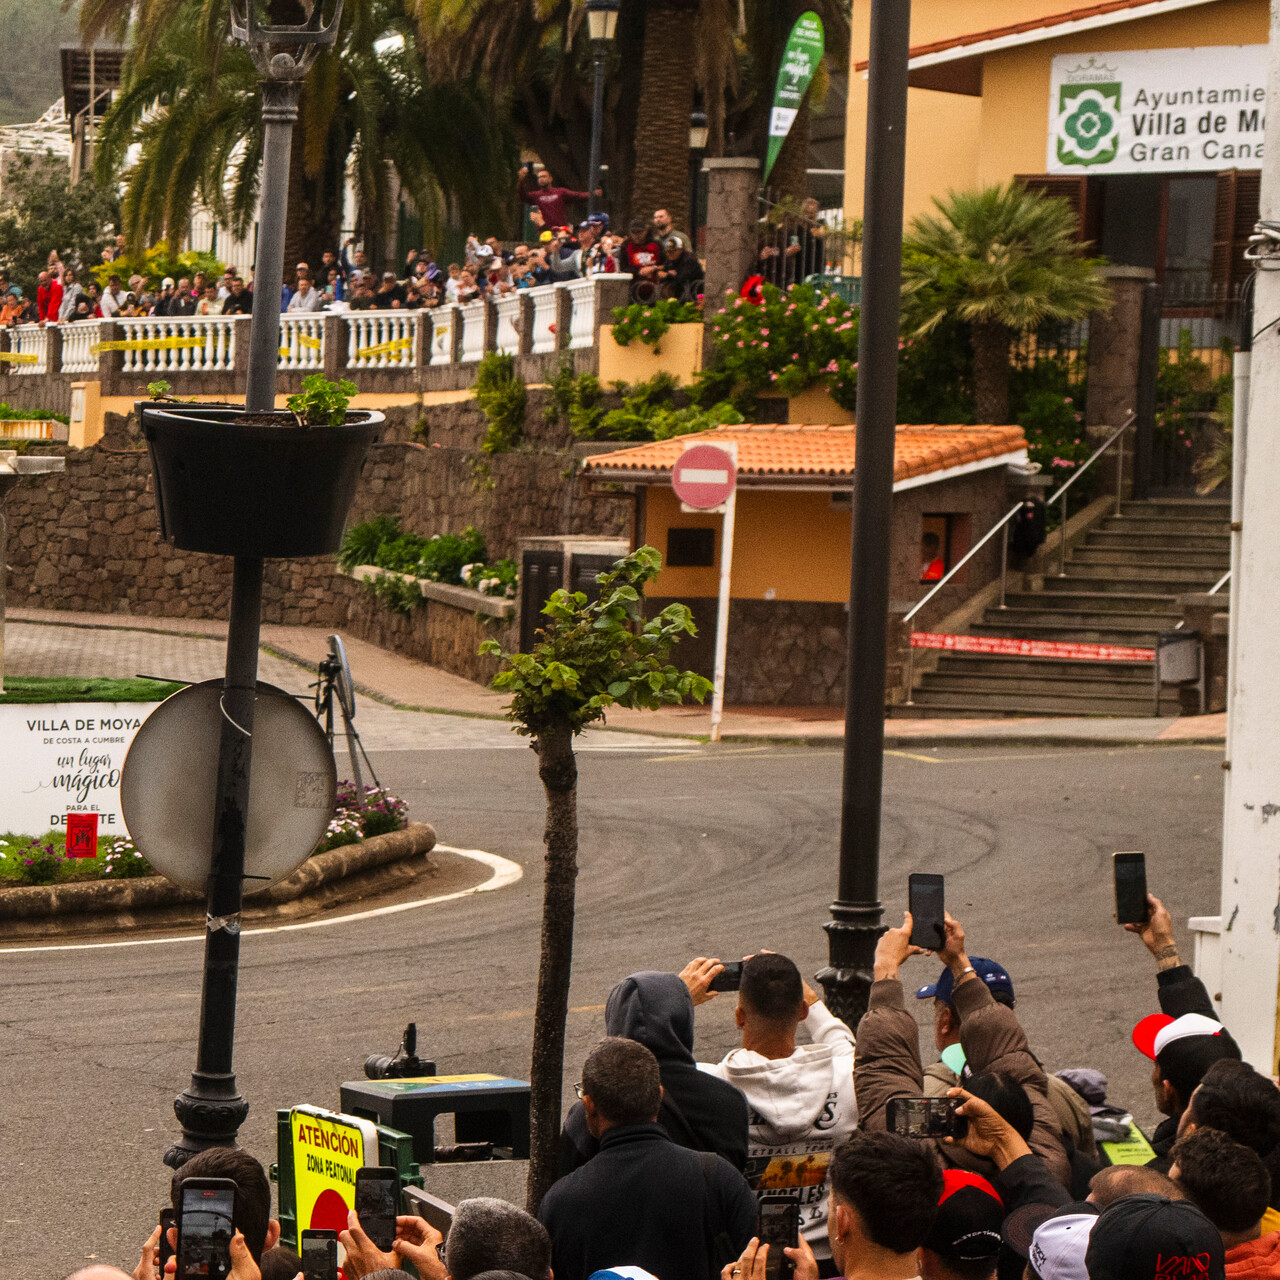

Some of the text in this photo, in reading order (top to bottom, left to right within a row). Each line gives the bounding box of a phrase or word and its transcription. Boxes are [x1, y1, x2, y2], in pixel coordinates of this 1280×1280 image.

[1133, 84, 1265, 111] Ayuntamie
[1132, 112, 1187, 136] Villa
[1198, 110, 1227, 134] de
[1130, 139, 1265, 162] Gran Cana
[26, 718, 141, 731] VILLA DE MOYA
[57, 748, 111, 774] un lugar
[52, 769, 122, 803] mágico
[50, 813, 116, 825] DETE
[298, 1123, 359, 1159] ATENCIÓN
[306, 1153, 356, 1187] ZONA PEATONAL
